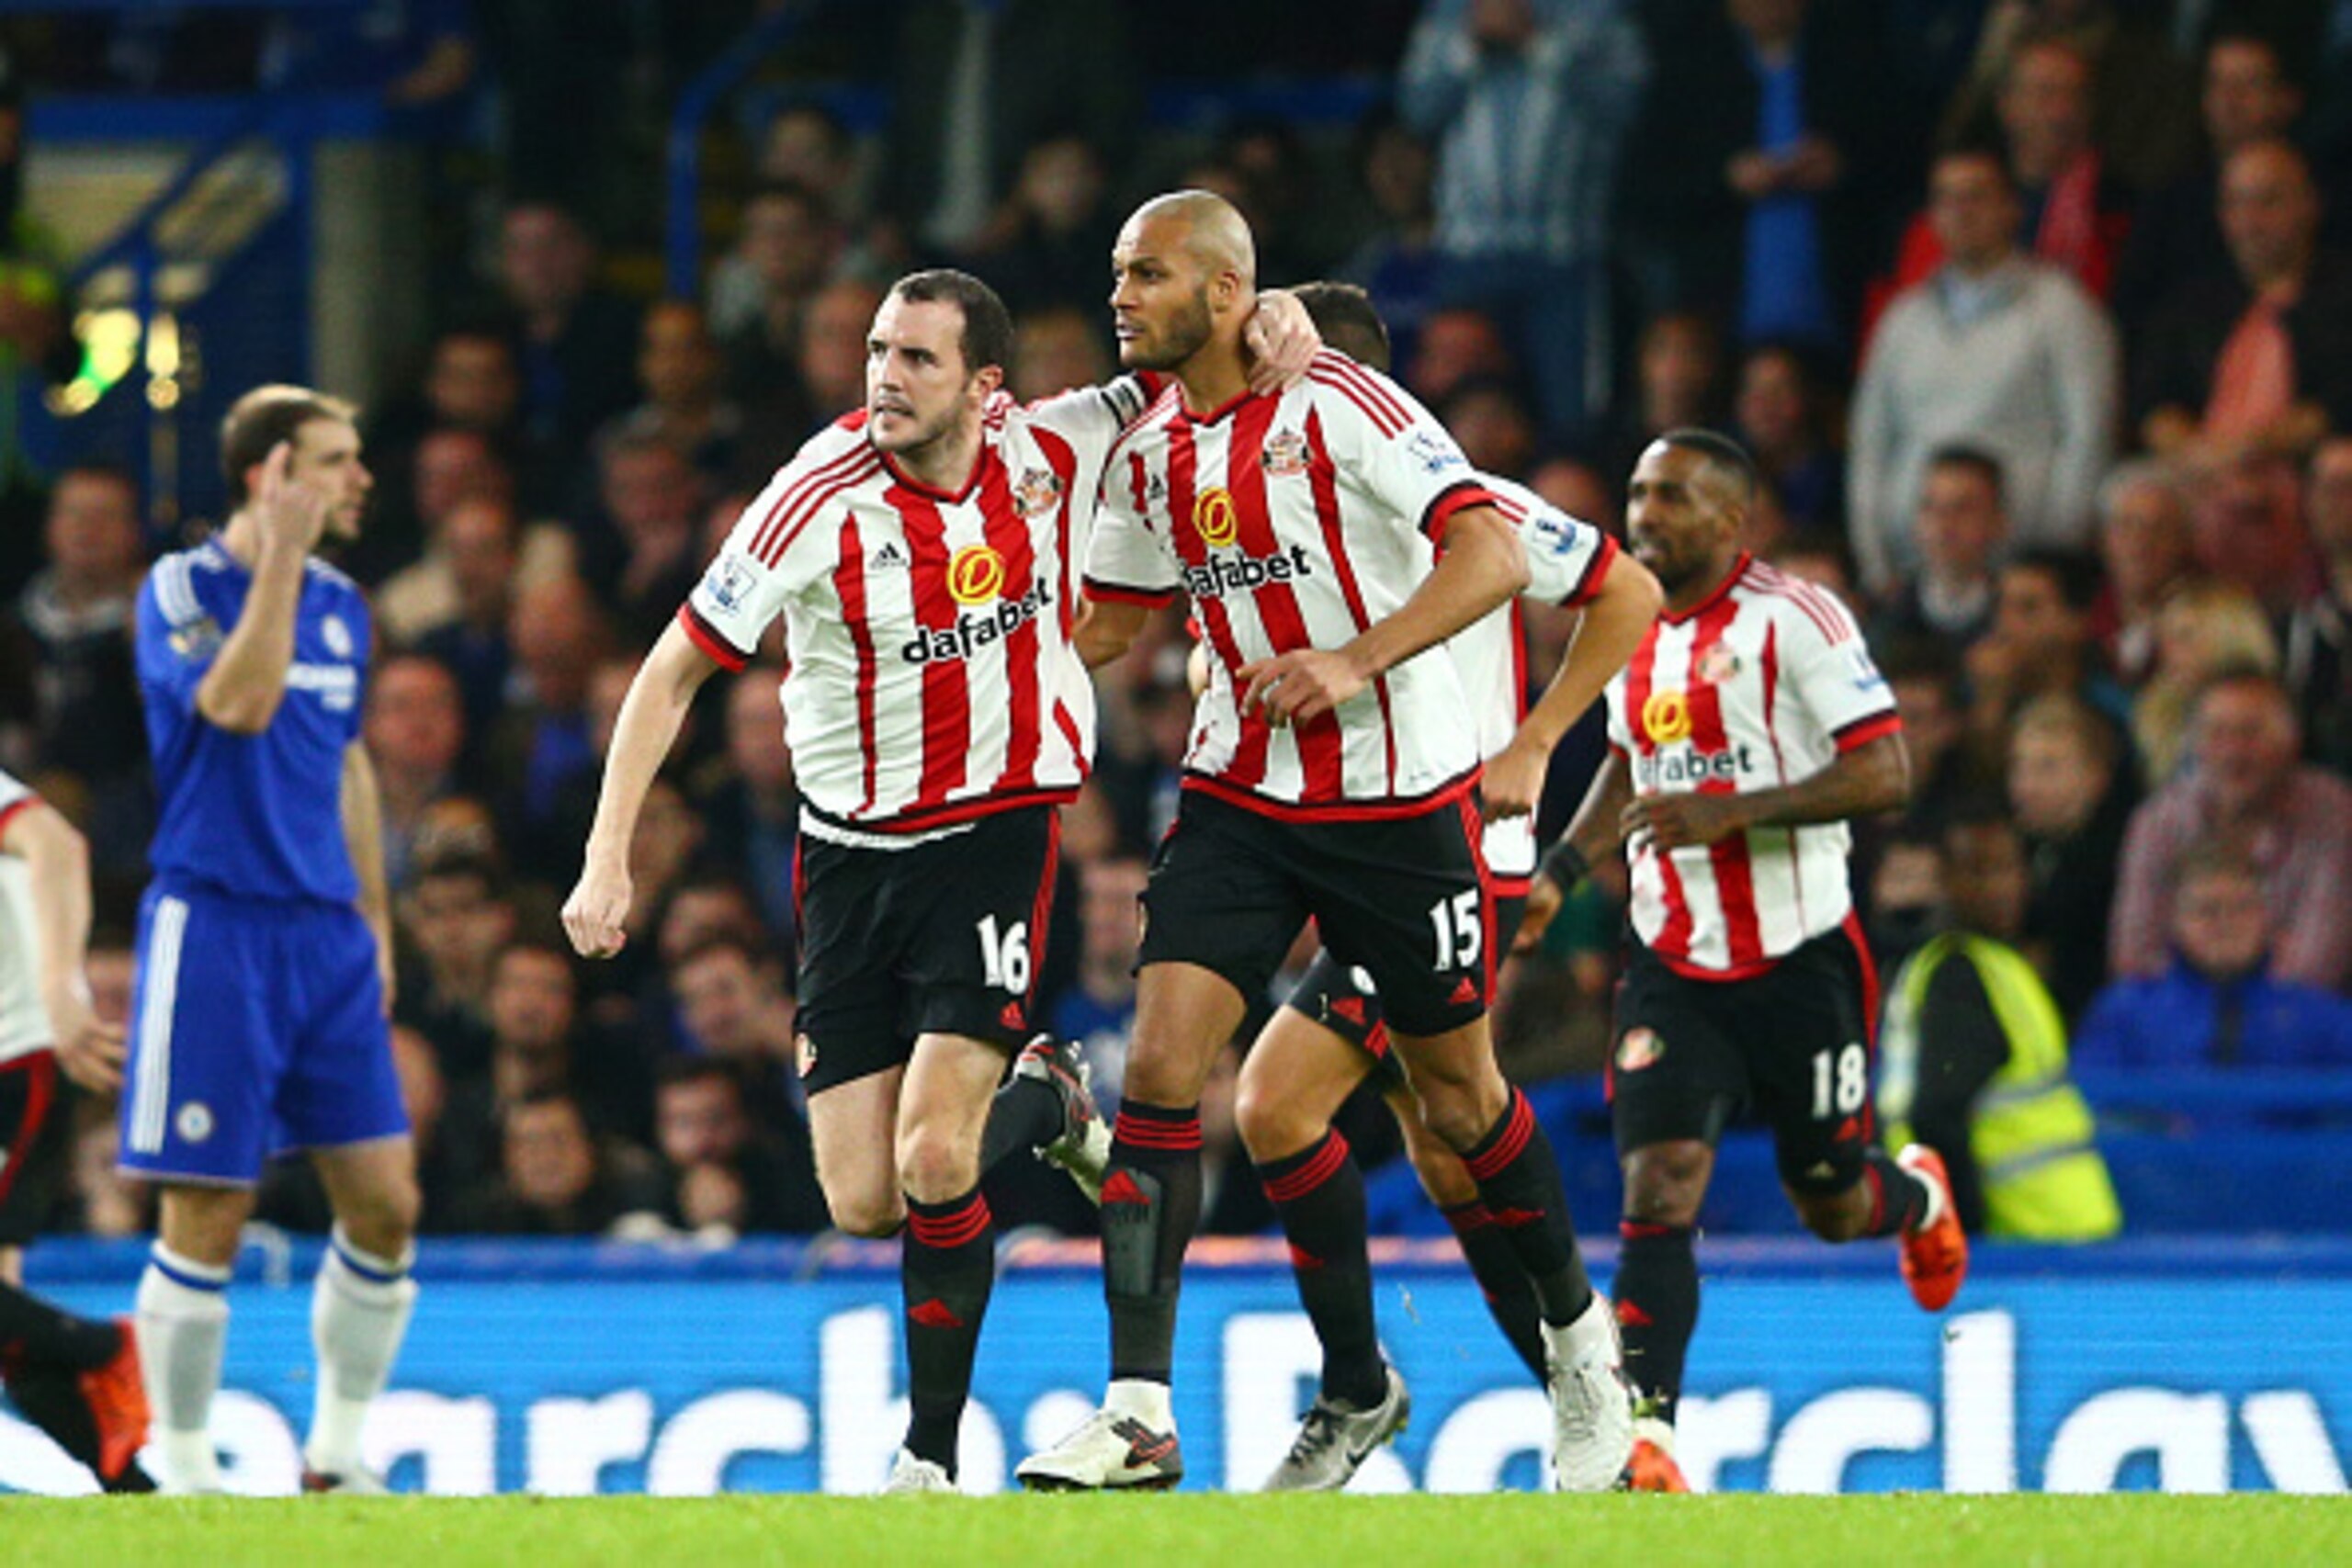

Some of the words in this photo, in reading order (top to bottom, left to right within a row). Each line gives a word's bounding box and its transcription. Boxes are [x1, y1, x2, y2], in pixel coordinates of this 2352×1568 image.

[901, 576, 1052, 663] dafabet
[977, 914, 1030, 994] 16
[1430, 887, 1482, 970] 15
[1813, 1043, 1866, 1117] 18
